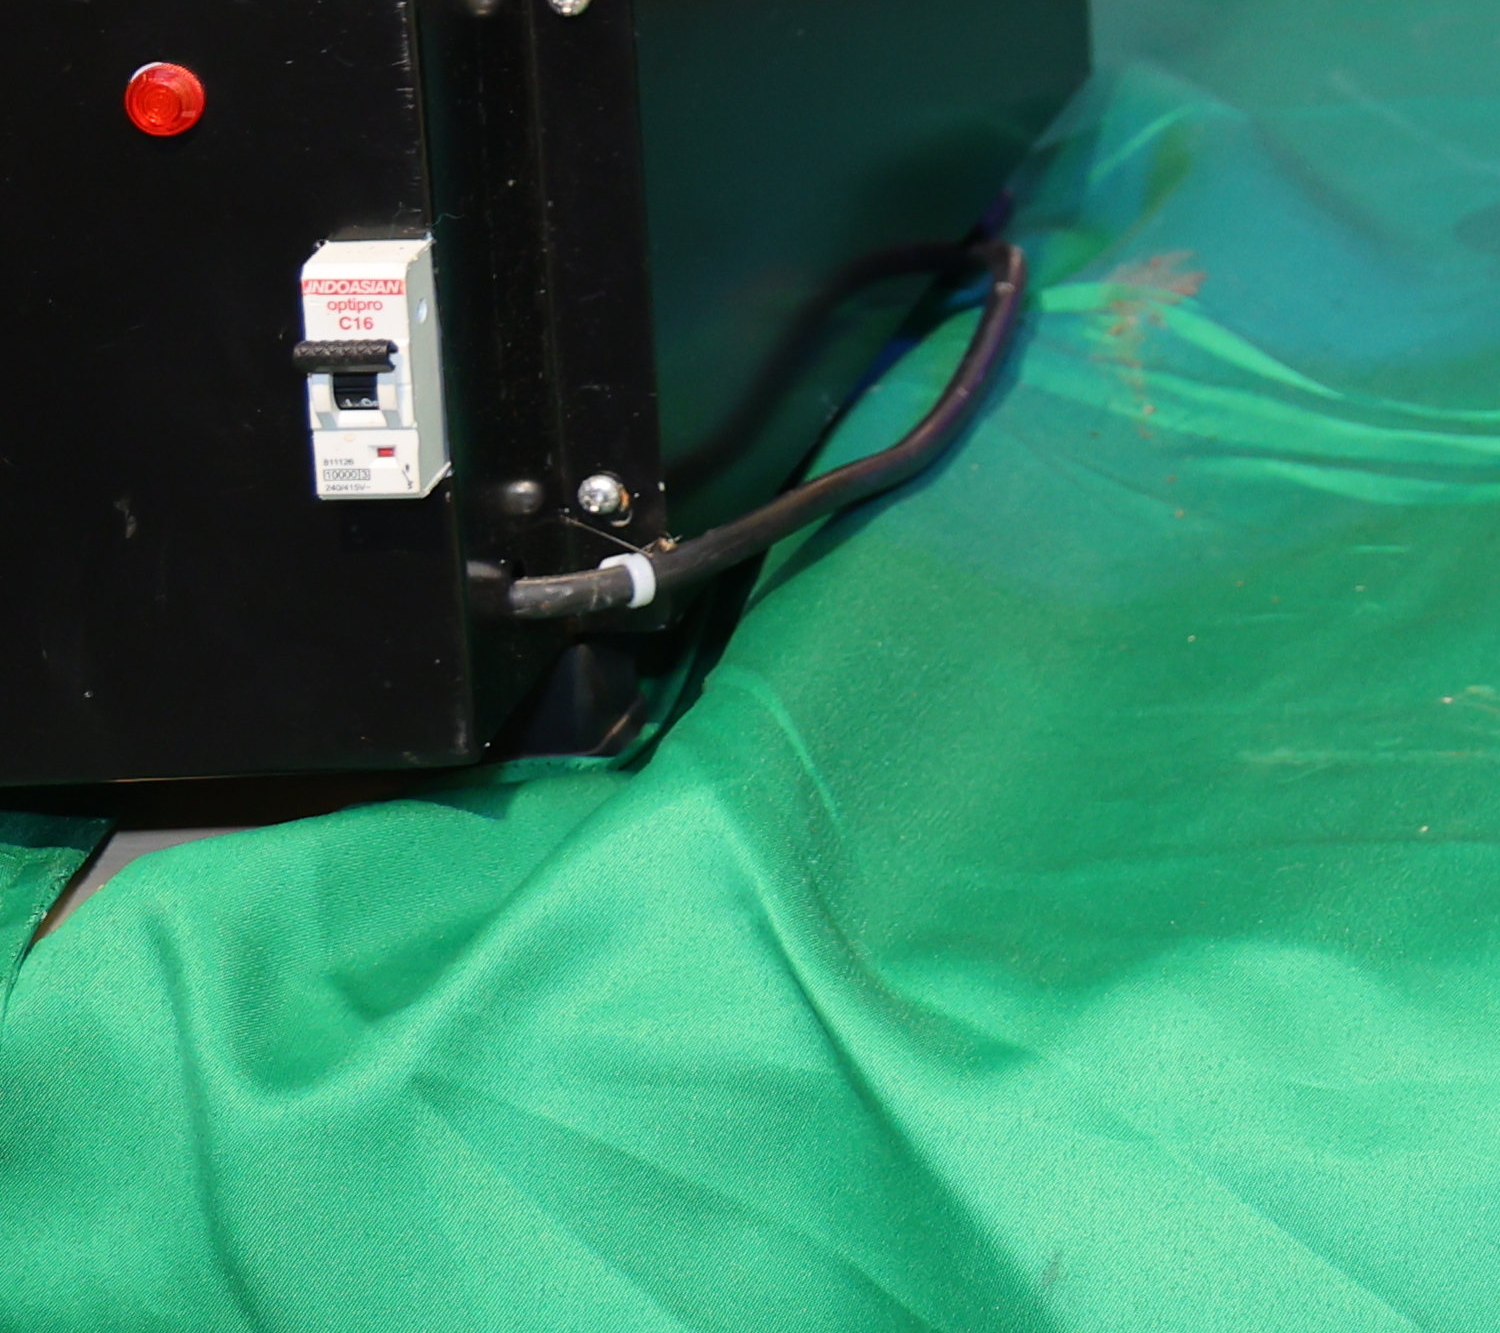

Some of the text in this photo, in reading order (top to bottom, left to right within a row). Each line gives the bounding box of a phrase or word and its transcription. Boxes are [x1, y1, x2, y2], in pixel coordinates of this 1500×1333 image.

[326, 298, 383, 314] optipro
[338, 316, 374, 331] C16
[325, 470, 357, 480] 10000
